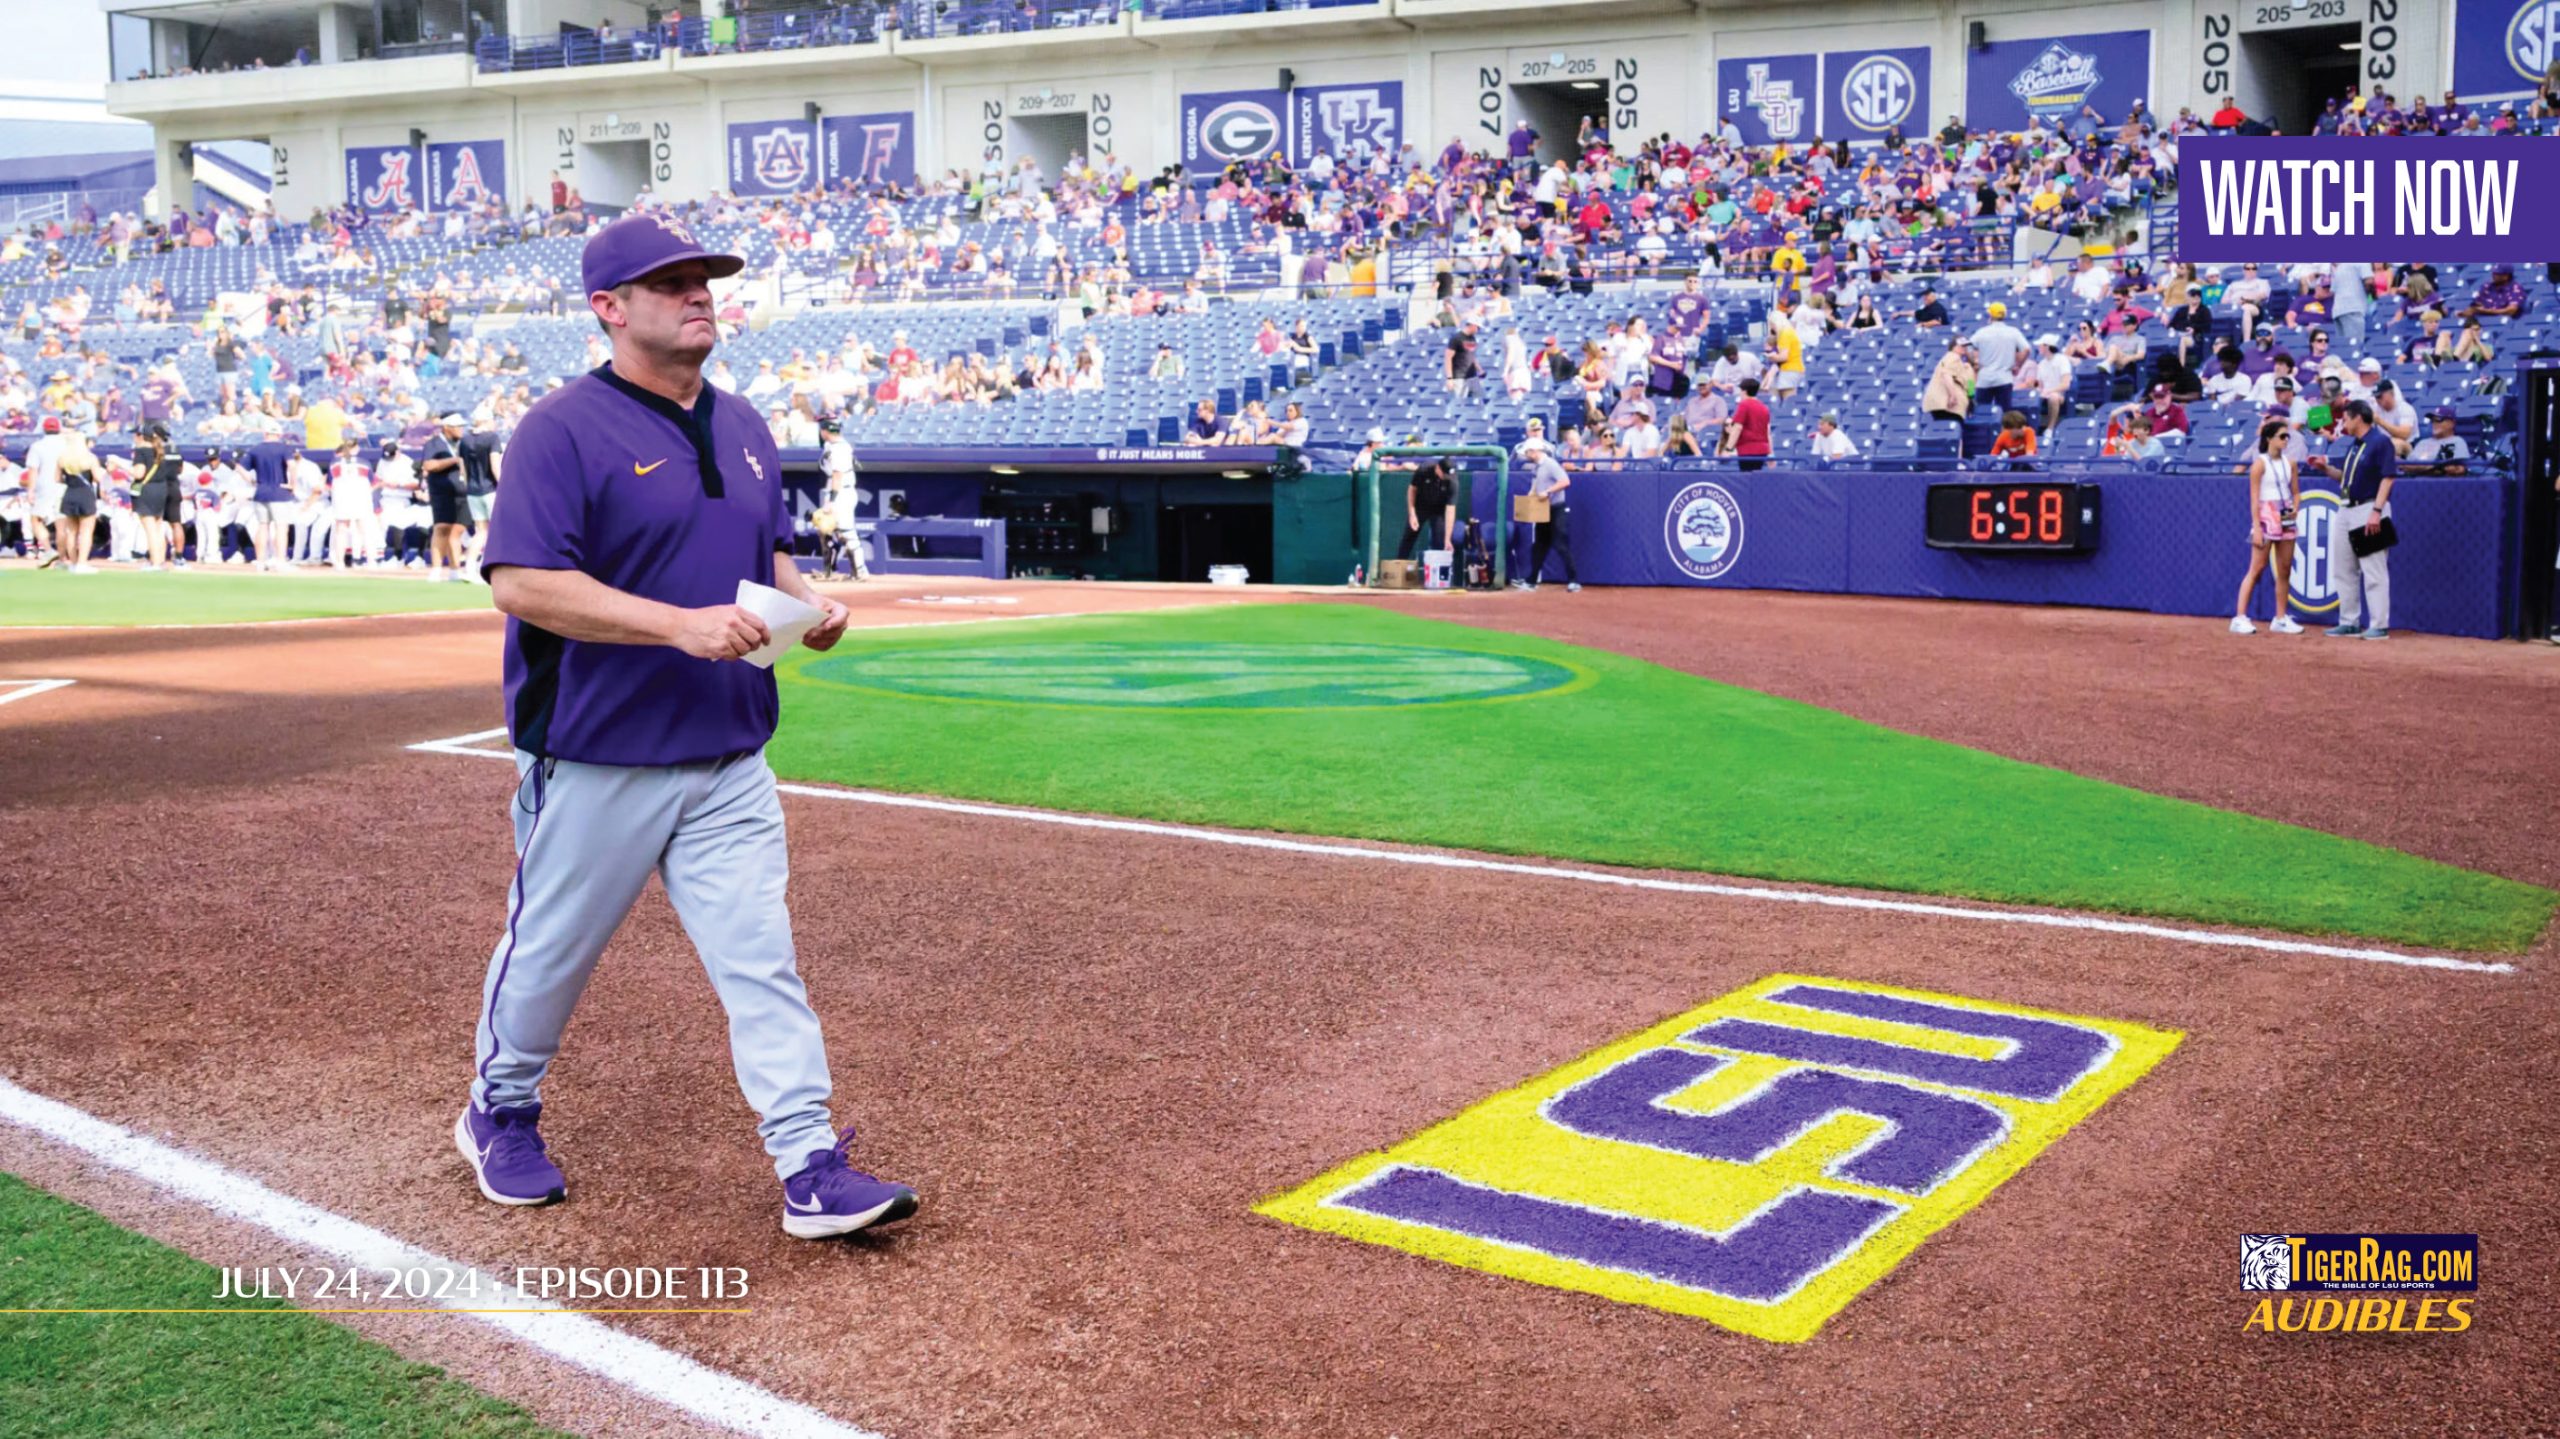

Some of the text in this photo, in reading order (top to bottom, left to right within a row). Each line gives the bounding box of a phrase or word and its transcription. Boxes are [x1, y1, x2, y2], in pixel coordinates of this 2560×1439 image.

[2256, 1, 2345, 24] 205 203
[2203, 14, 2231, 94] 205
[2368, 0, 2397, 80] 203
[1522, 59, 1596, 77] 207 205
[2016, 56, 2096, 94] Baseball
[1019, 94, 1077, 109] 209 207
[1480, 67, 1502, 136] 207
[1615, 58, 1638, 130] 205
[1728, 88, 1740, 113] LSU
[1851, 64, 1905, 123] SEC
[558, 127, 574, 169] 211
[1092, 94, 1112, 156] 207
[1186, 107, 1198, 161] GEORGIA
[1301, 96, 1312, 160] KENTUCKY
[274, 147, 289, 187] 211
[654, 122, 672, 182] 209
[733, 137, 742, 183] AUBURN
[830, 131, 839, 178] FLORIDA
[350, 157, 359, 206] ALABAMA
[1108, 449, 1118, 459] IT
[1118, 449, 1140, 459] JUST
[1142, 449, 1174, 459] MEANS
[1674, 488, 1737, 519] CITY OF HOOVER
[1971, 491, 2062, 541] 6:58
[1683, 560, 1725, 574] ALABAMA
[1317, 983, 2123, 1306] LSU
